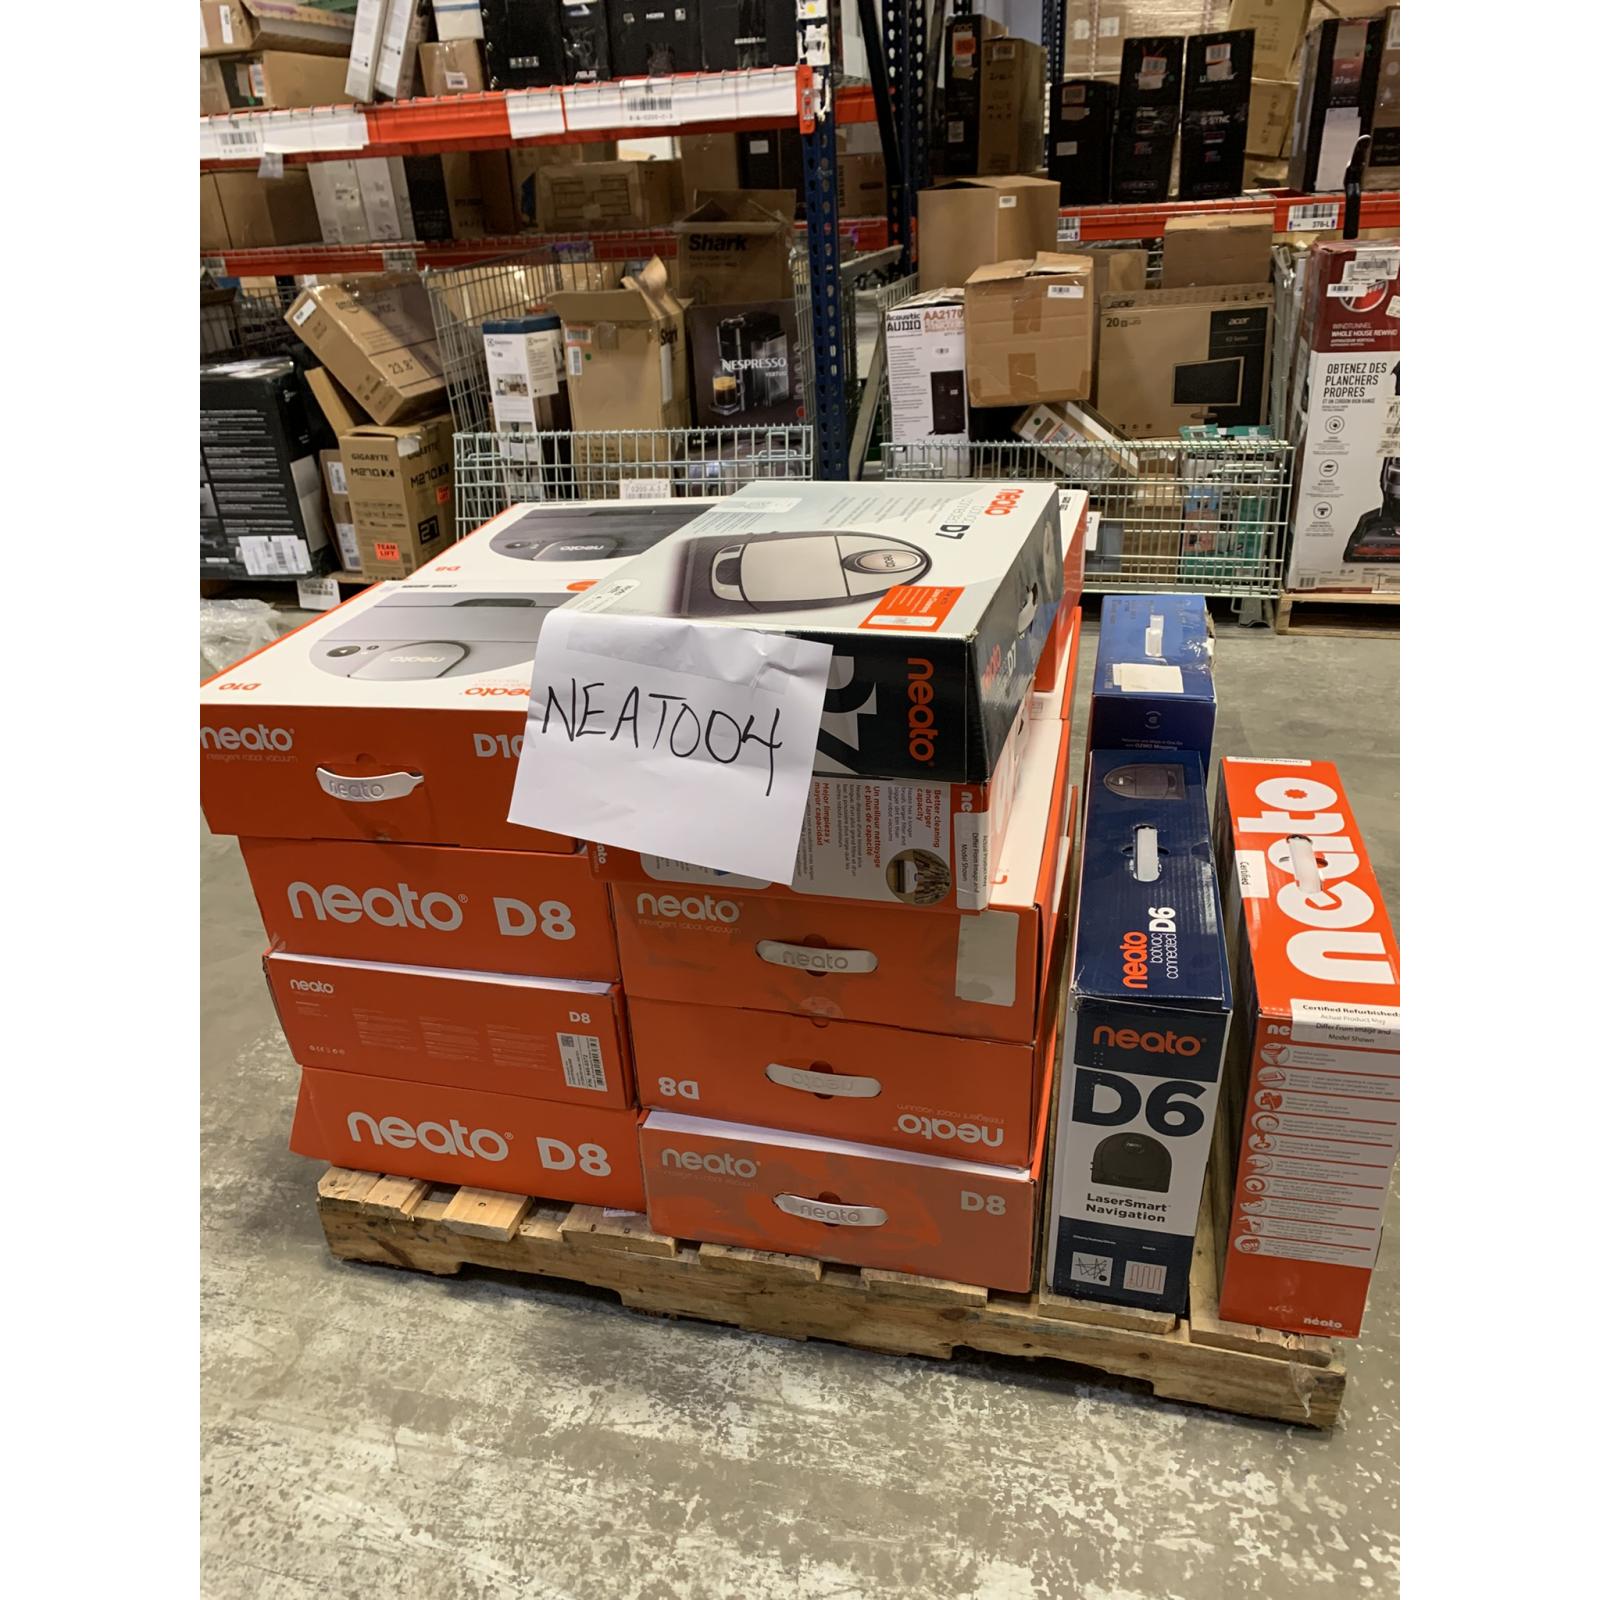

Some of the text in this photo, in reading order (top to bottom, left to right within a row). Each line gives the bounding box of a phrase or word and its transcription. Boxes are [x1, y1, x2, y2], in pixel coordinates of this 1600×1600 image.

[688, 233, 747, 251] Shark
[886, 313, 921, 322] Acoustic
[886, 320, 922, 332] AUDIO
[1106, 317, 1120, 328] 20
[1228, 317, 1250, 326] acer
[721, 357, 787, 373] NESPRESSO
[1327, 362, 1388, 374] OBTENEZ DES
[1324, 375, 1379, 386] PLANCHERS
[1322, 386, 1366, 398] PROPRES
[352, 453, 388, 461] GIGABYTE
[984, 488, 1024, 516] neato
[935, 524, 970, 540] D7
[560, 544, 605, 552] neato
[218, 682, 262, 692] D10
[907, 657, 939, 763] neato
[200, 723, 294, 752] neato
[541, 677, 783, 797] NEATO04
[328, 780, 385, 799] neato
[1237, 776, 1396, 985] neato
[286, 880, 577, 942] neato D8
[636, 892, 742, 924] neato
[1148, 906, 1177, 934] D6
[1150, 932, 1164, 964] botvac
[1166, 932, 1179, 980] connected
[782, 950, 850, 970] neato
[1118, 931, 1148, 990] neato
[289, 978, 334, 995] neato
[568, 1010, 592, 1026] D8
[1302, 1004, 1340, 1014] Certified
[1316, 1022, 1392, 1036] Differ From Image and
[1320, 1014, 1340, 1023] Actual
[1342, 1016, 1369, 1025] Product
[1092, 1025, 1202, 1058] neato
[1328, 1033, 1375, 1045] Model Shown
[658, 1077, 700, 1101] D8
[791, 1072, 855, 1092] neato
[1072, 1067, 1208, 1138] D6
[897, 1114, 1004, 1148] neato
[347, 1110, 612, 1178] neato D8
[661, 1147, 758, 1180] neato
[960, 1190, 1007, 1216] D8
[1086, 1192, 1168, 1213] LaserSmart
[800, 1203, 862, 1224] neato
[1085, 1203, 1167, 1224] Navigation
[1303, 1316, 1343, 1330] neato
